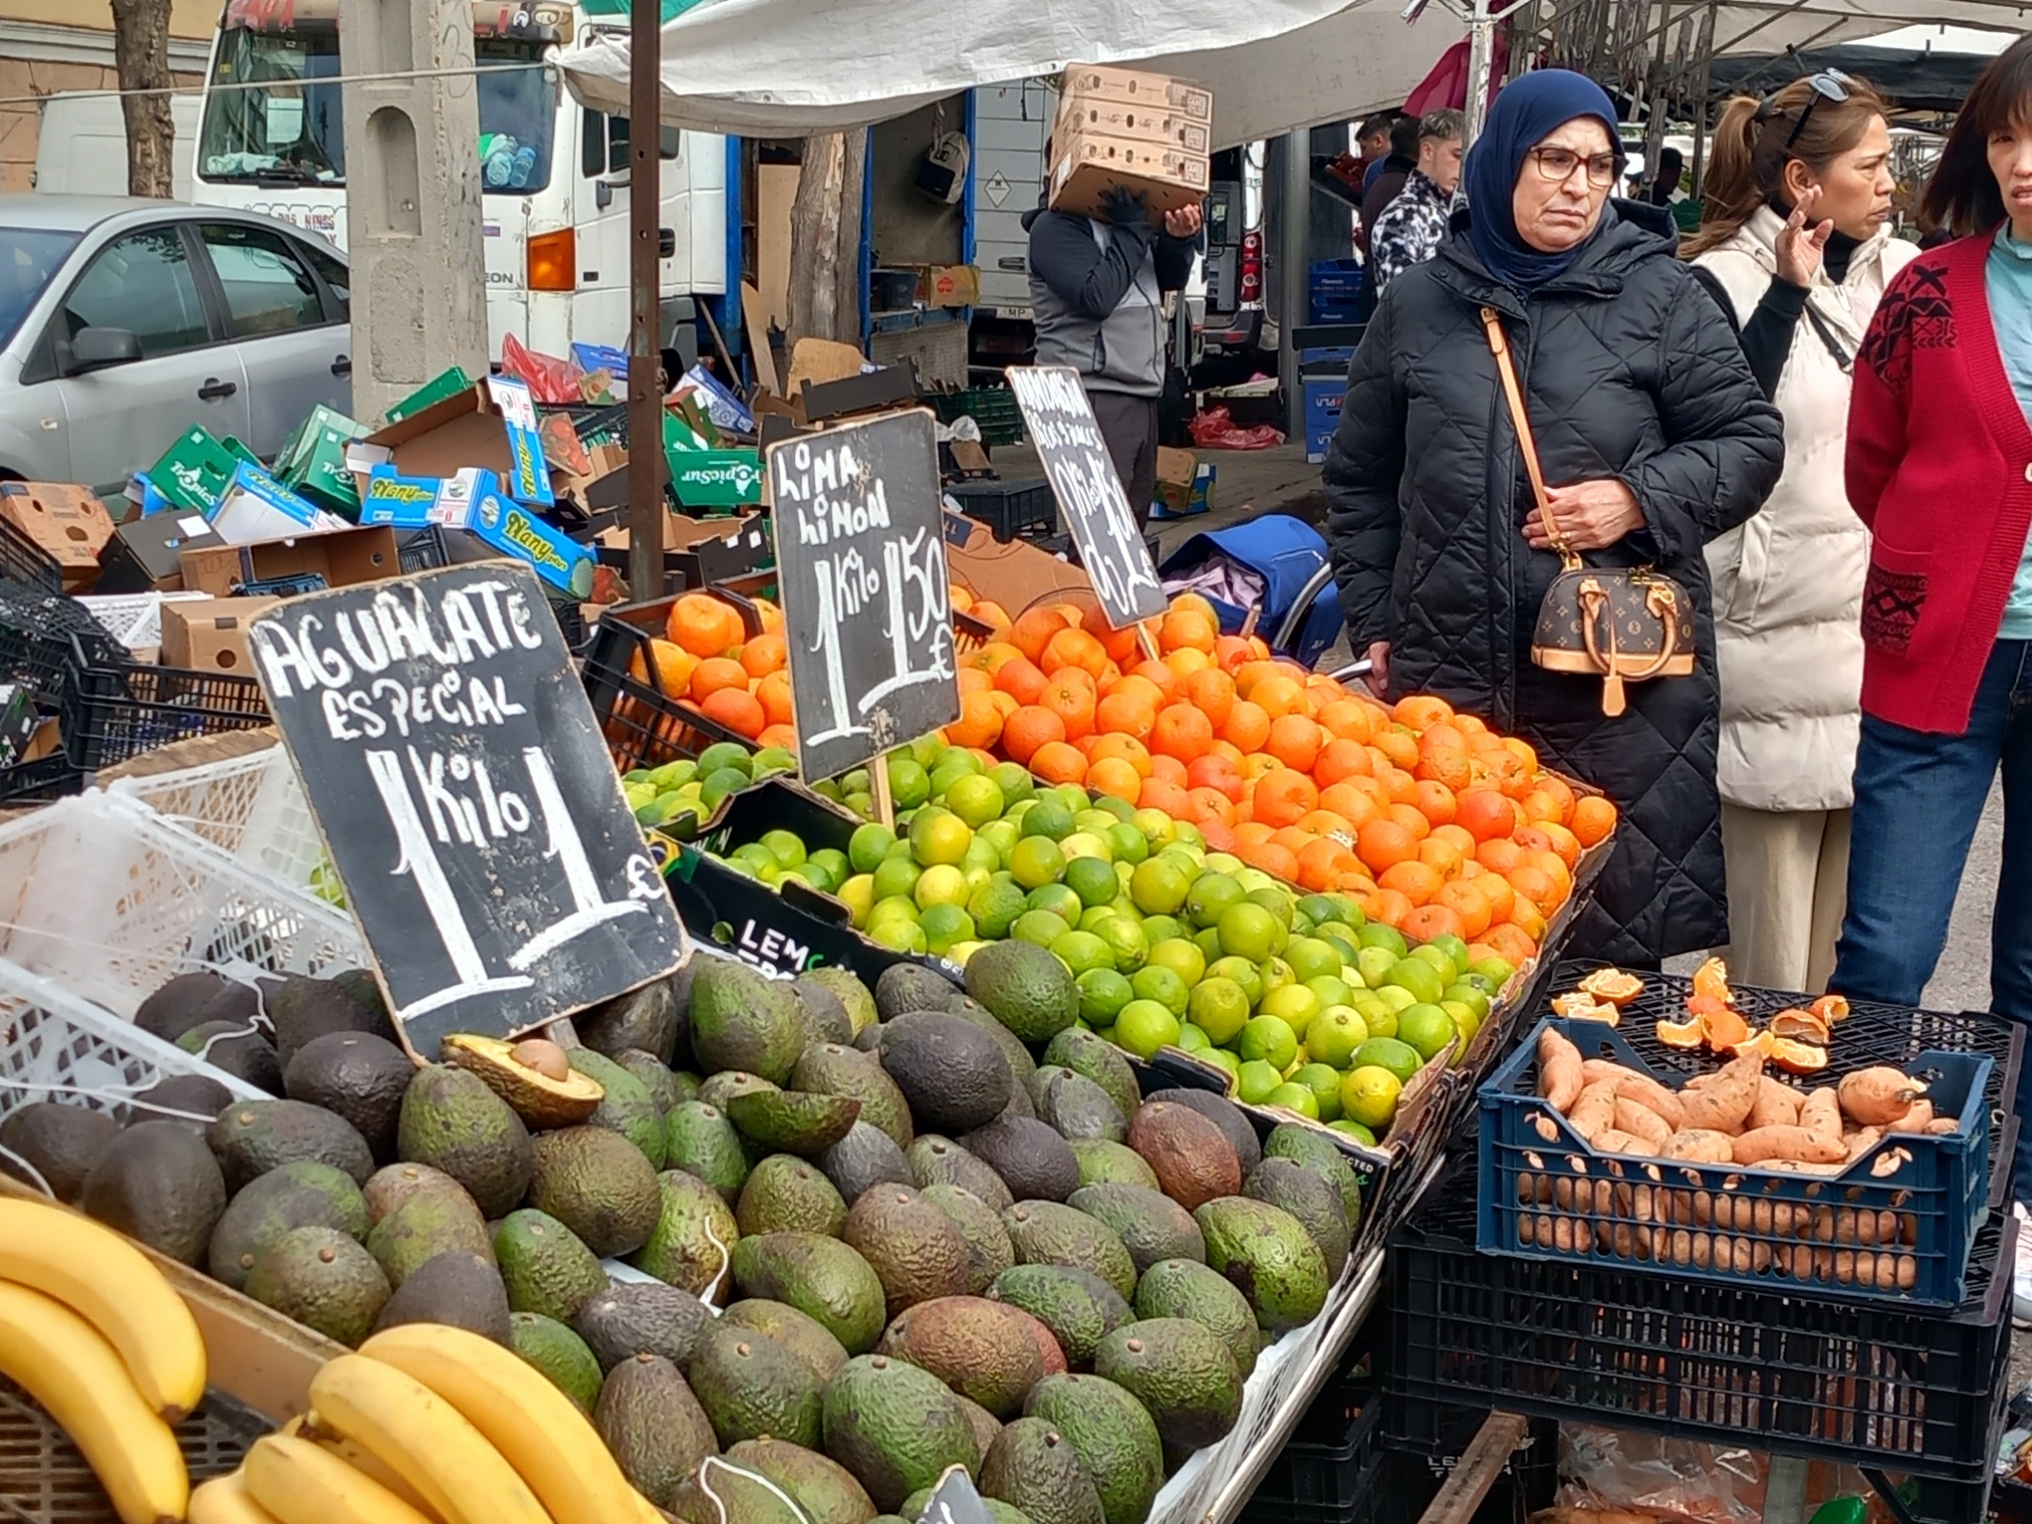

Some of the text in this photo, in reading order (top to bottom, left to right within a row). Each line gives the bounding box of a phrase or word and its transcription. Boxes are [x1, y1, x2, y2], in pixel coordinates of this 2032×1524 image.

[372, 480, 418, 504] Nany
[507, 513, 551, 562] Nany
[252, 580, 542, 698] AGUACATE
[1341, 1154, 1374, 1173] CTED
